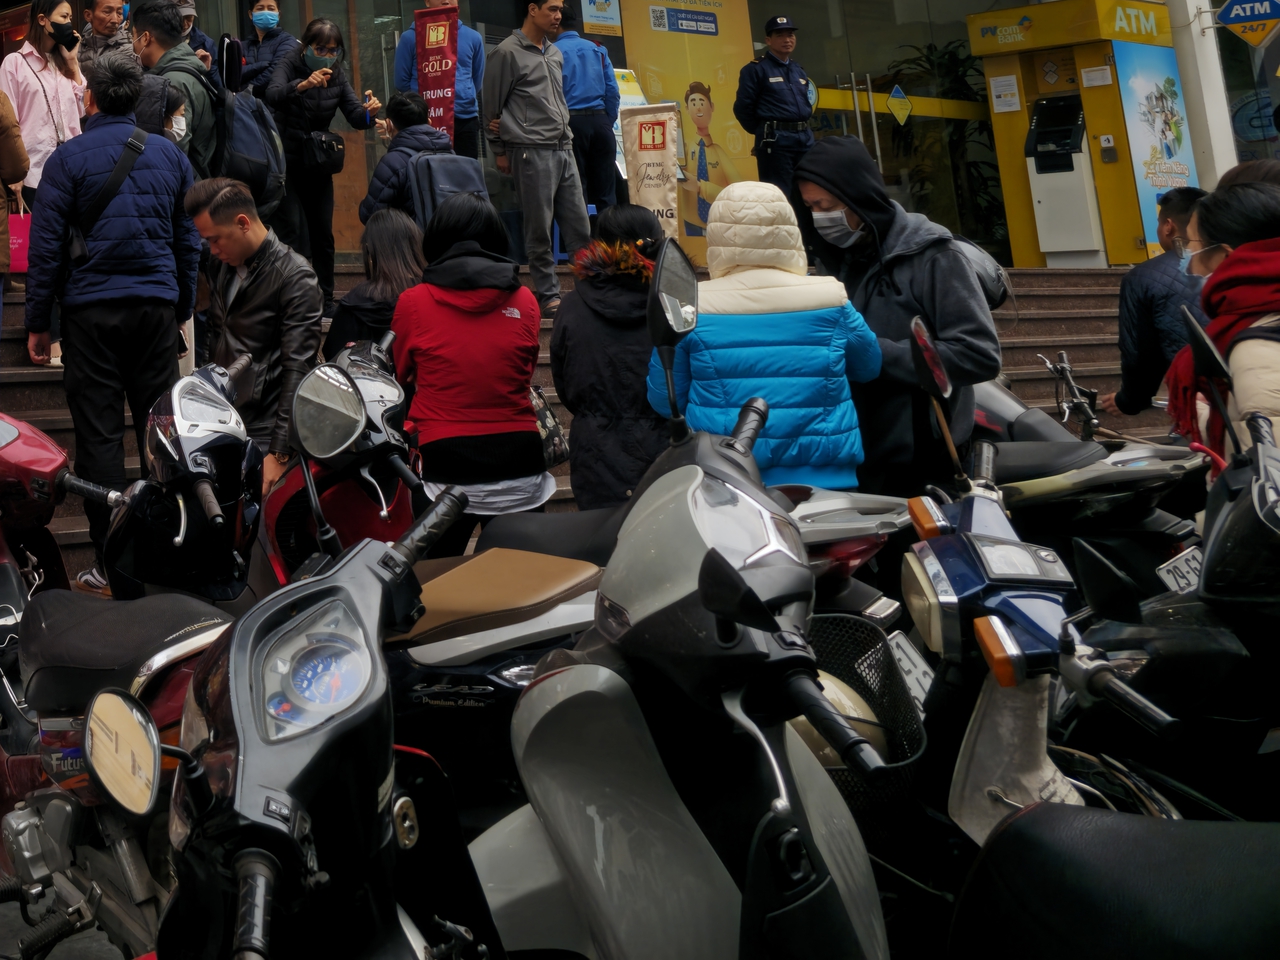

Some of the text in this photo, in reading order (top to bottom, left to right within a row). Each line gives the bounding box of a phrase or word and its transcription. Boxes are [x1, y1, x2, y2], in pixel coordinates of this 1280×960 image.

[1229, 0, 1271, 18] ATM
[1114, 5, 1158, 37] ATM
[1240, 22, 1268, 34] 24/7
[422, 59, 453, 74] GOLD
[422, 87, 453, 101] TRUNG
[50, 752, 86, 774] Futu
